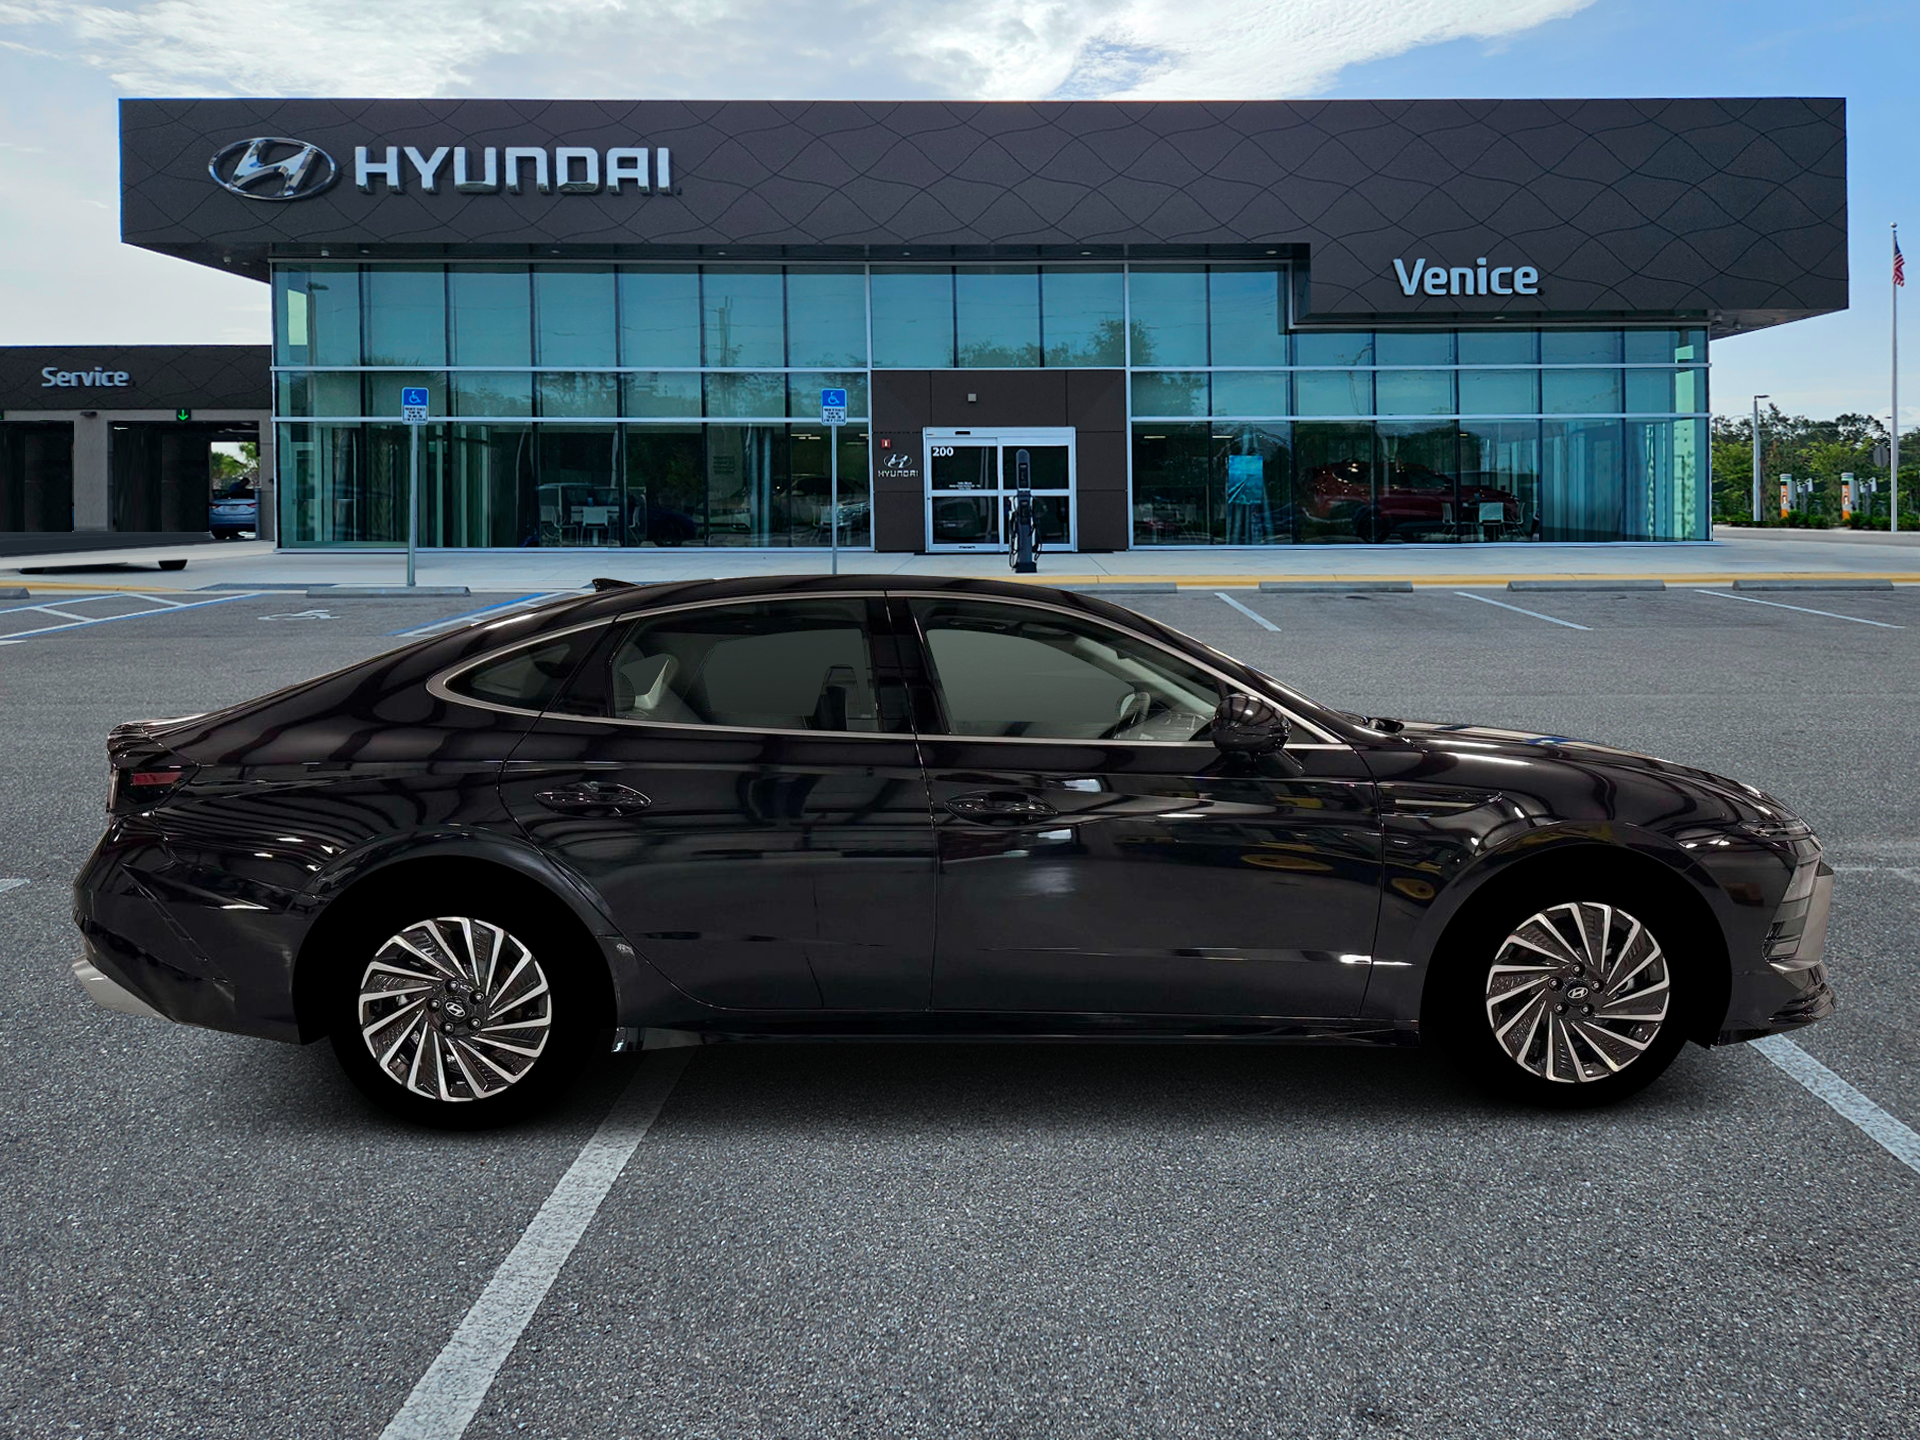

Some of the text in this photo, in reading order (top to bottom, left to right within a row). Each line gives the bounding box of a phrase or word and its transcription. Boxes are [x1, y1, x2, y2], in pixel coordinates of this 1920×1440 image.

[354, 145, 671, 194] HYUNDAI
[1393, 257, 1539, 296] Venice
[41, 366, 130, 387] Service
[932, 446, 954, 457] 200
[877, 470, 919, 478] HYUNDAI
